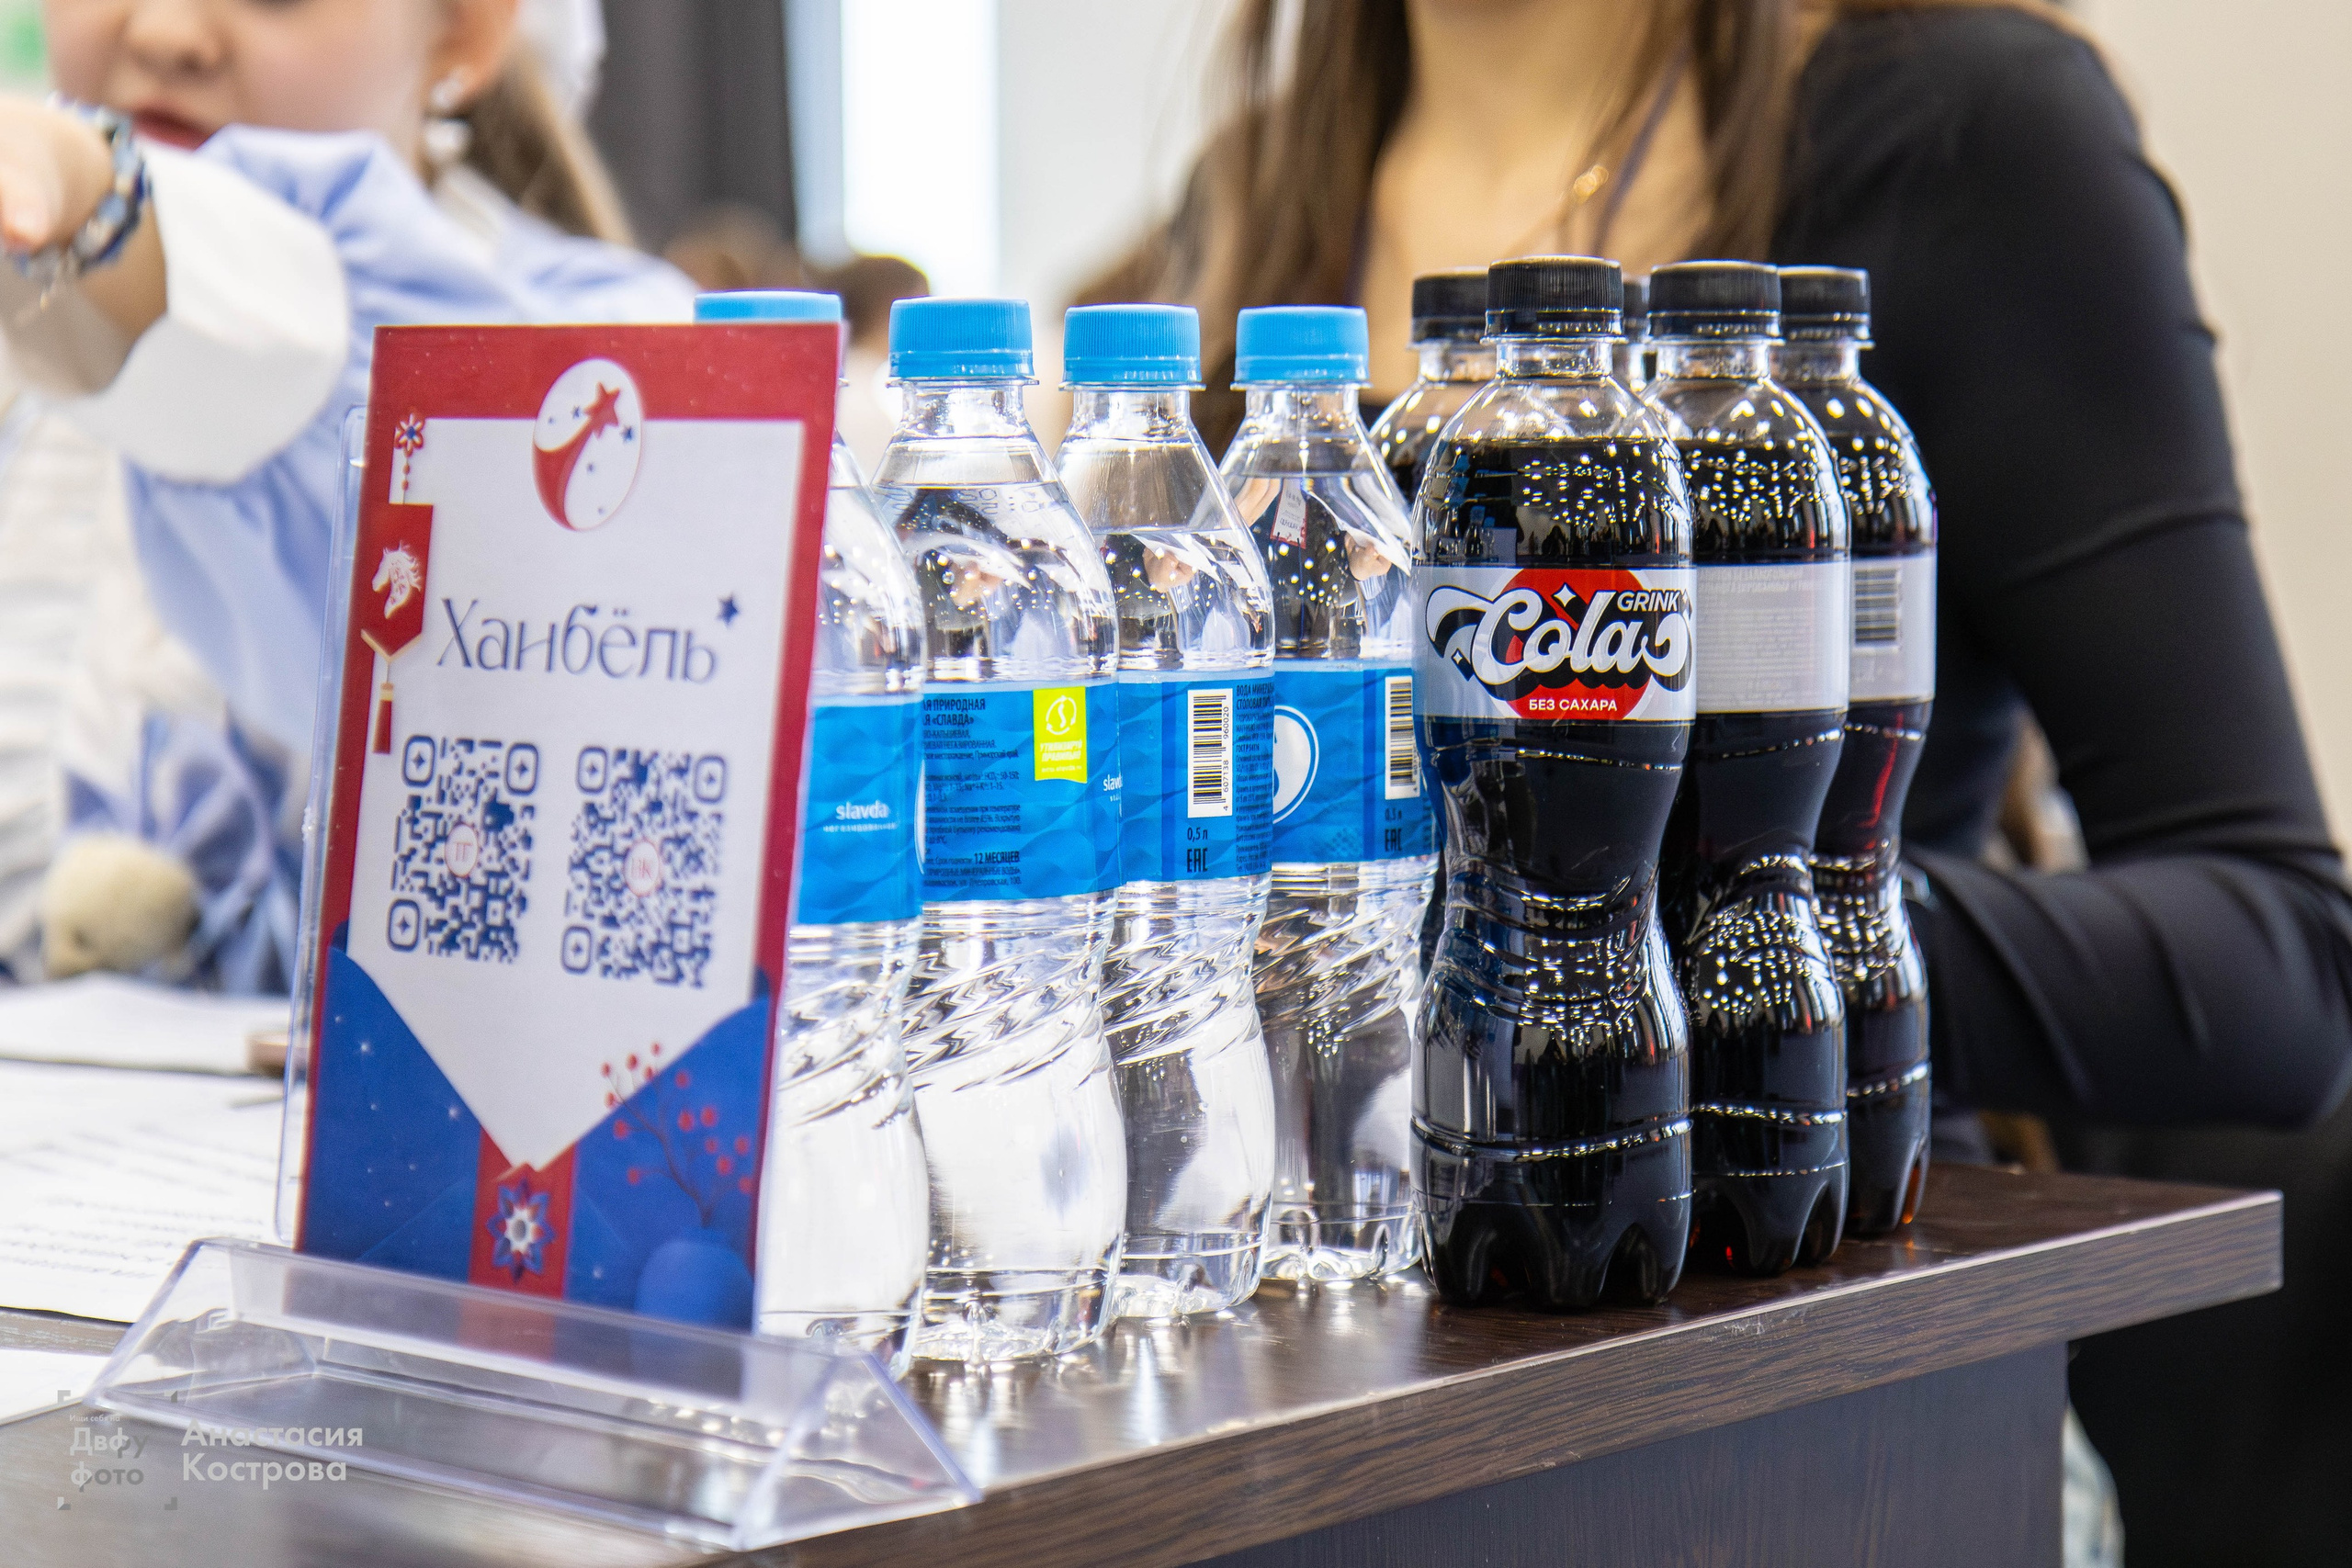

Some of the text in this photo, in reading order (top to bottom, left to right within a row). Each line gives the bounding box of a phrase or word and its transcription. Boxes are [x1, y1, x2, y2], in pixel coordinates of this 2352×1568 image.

[1617, 591, 1680, 612] GRINK
[436, 597, 717, 684] Ханбёль
[1426, 586, 1689, 685] Cola
[933, 698, 986, 712] ПРИРОДНАЯ
[1529, 698, 1618, 712] БЕЗ САХАРА
[932, 713, 974, 727] «СЛАВДА»
[836, 800, 890, 820] slavda
[1187, 828, 1208, 842] 0,5 л
[974, 852, 983, 864] 12
[985, 851, 1020, 864] МЕСЯЦЕВ
